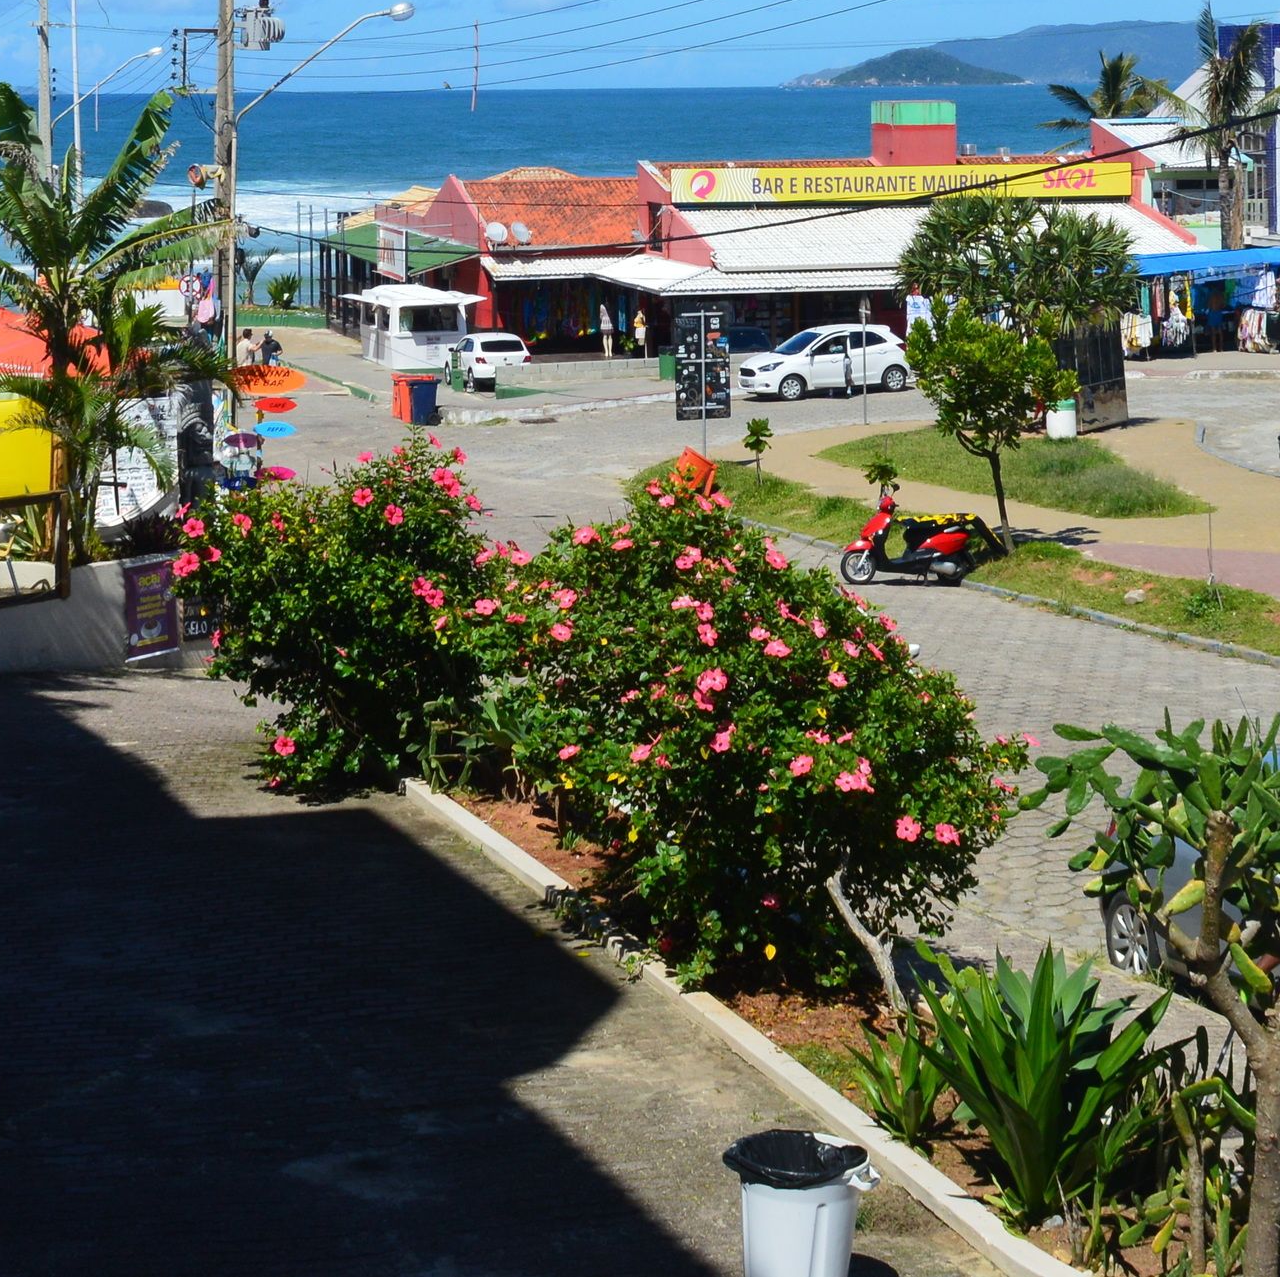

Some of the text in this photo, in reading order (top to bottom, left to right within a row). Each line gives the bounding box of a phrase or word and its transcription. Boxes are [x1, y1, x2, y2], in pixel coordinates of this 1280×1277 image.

[752, 177, 784, 194] BAR
[790, 177, 798, 193] E
[804, 175, 916, 194] RESTAURANTE
[1042, 167, 1097, 191] SKOL
